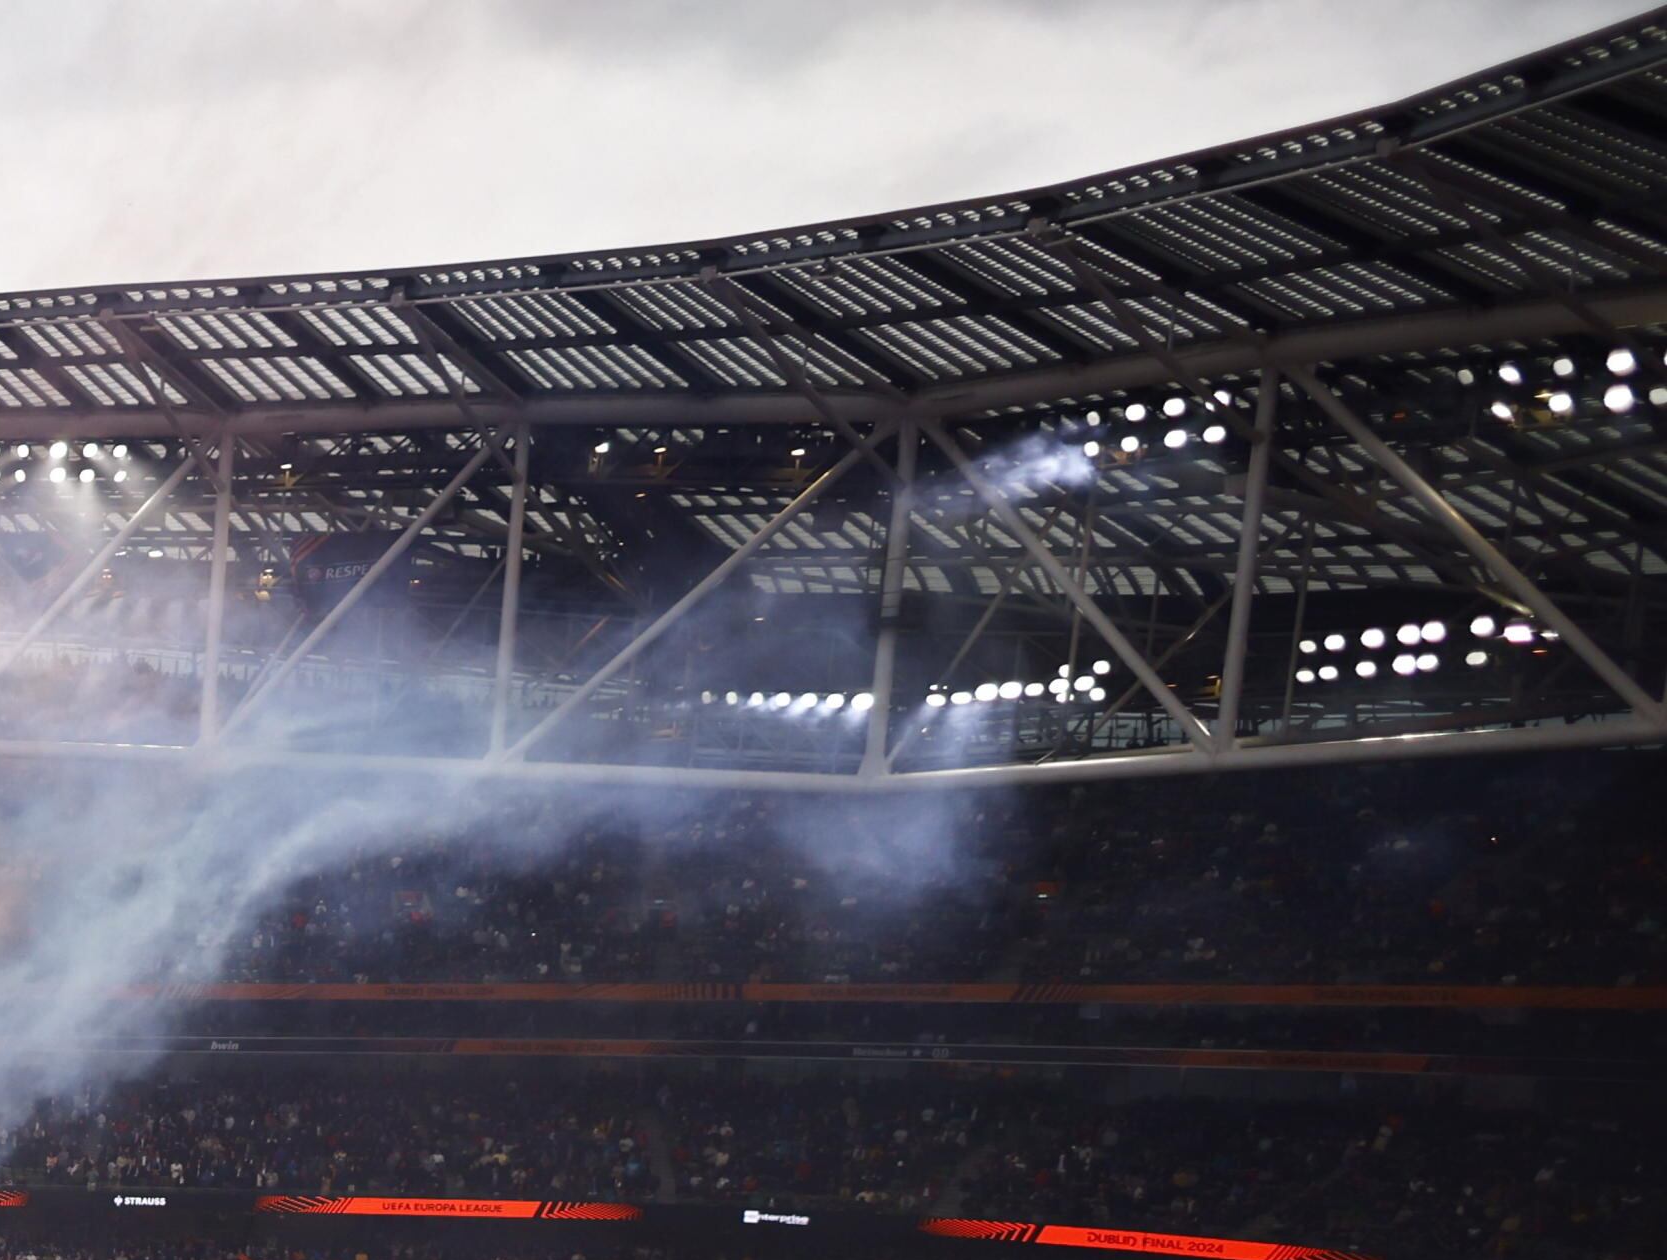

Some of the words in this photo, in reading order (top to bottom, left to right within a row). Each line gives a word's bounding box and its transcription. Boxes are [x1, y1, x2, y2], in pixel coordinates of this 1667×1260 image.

[124, 1197, 167, 1206] STRAUSS
[382, 1202, 412, 1210] UEFA
[414, 1203, 457, 1212] EUROPA
[459, 1204, 503, 1213] LEAGUE
[1142, 1237, 1184, 1250] FINAL
[1187, 1241, 1224, 1253] 2024
